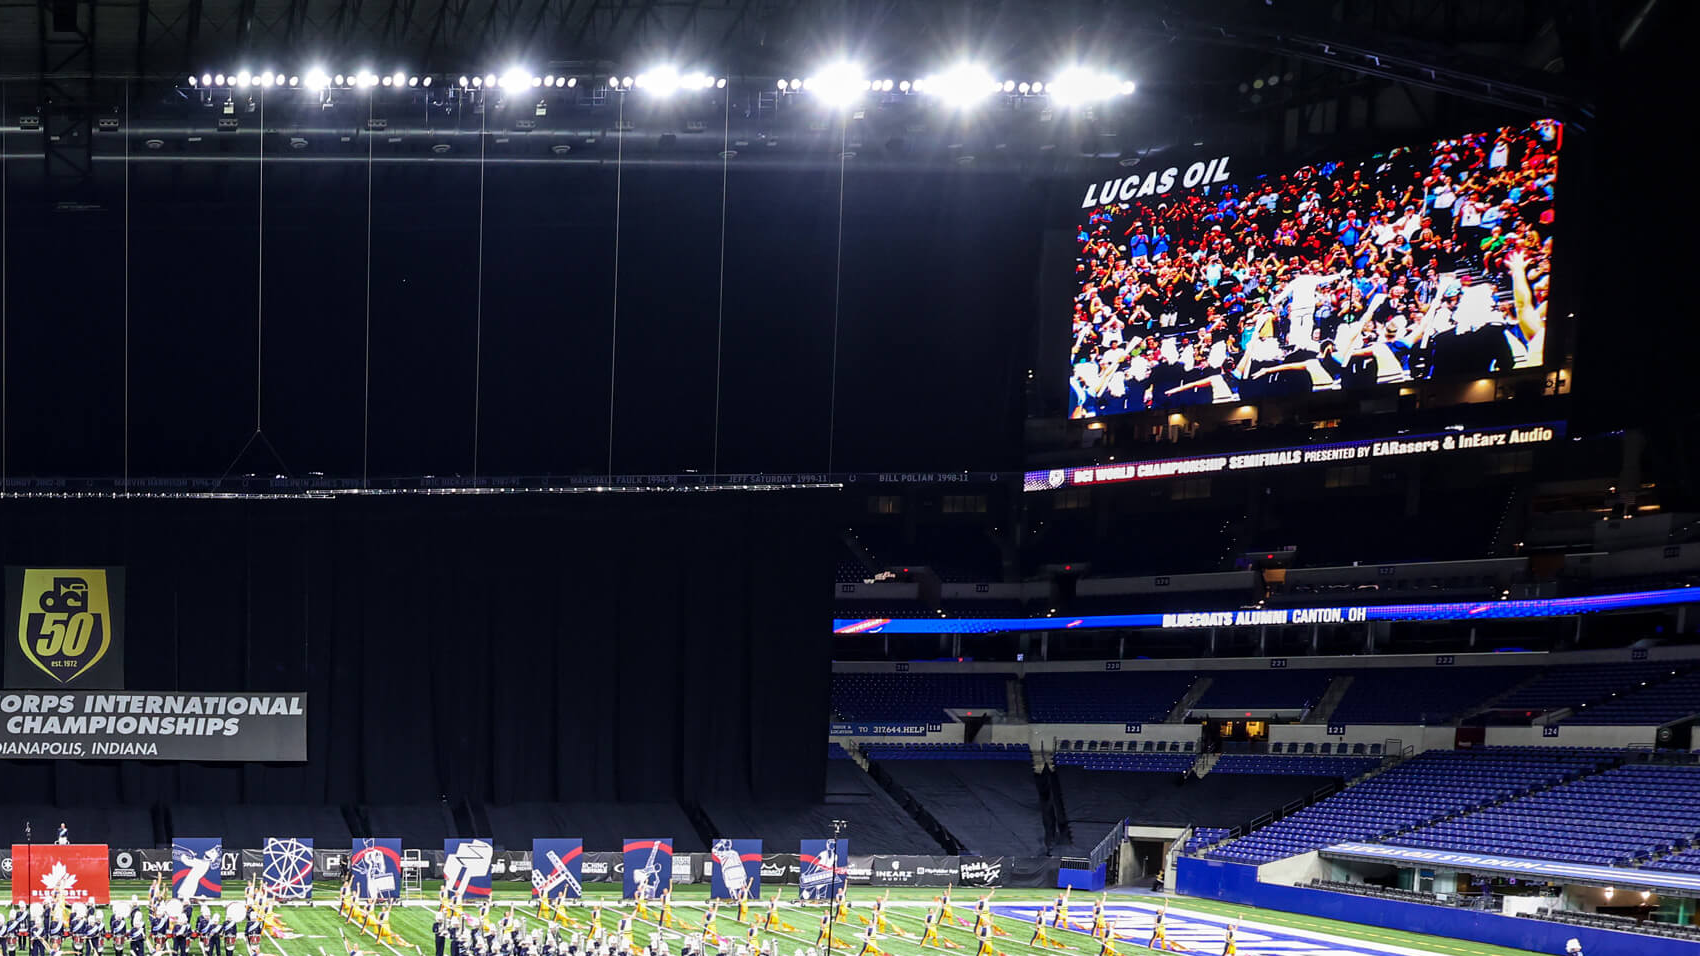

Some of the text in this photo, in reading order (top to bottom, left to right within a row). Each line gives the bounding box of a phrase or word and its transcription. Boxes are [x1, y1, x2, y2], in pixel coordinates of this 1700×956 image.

[1082, 156, 1231, 209] LUCAS OIL
[1095, 466, 1135, 481] WORLD
[1137, 457, 1226, 477] CHAMPIONSHIP
[1229, 450, 1301, 469] SEMIFINALS
[1304, 448, 1355, 463] PRESENTED
[1357, 447, 1370, 458] BY
[1373, 439, 1439, 456] EARasers
[1443, 437, 1455, 450] &
[1459, 433, 1506, 449] InEarz
[1509, 427, 1552, 444] Audio
[880, 474, 898, 482] BILL
[901, 474, 933, 482] POLIAN
[1163, 608, 1366, 627] BLUECOATS ALUMNI CANTON, OH
[36, 612, 94, 657] 50
[84, 695, 303, 716] INTERNATIONAL
[6, 715, 240, 736] CHAMPIONSHIPS
[1544, 727, 1557, 735] 124
[91, 743, 158, 755] INDIANA
[960, 862, 981, 872] Field
[962, 870, 985, 880] Floor
